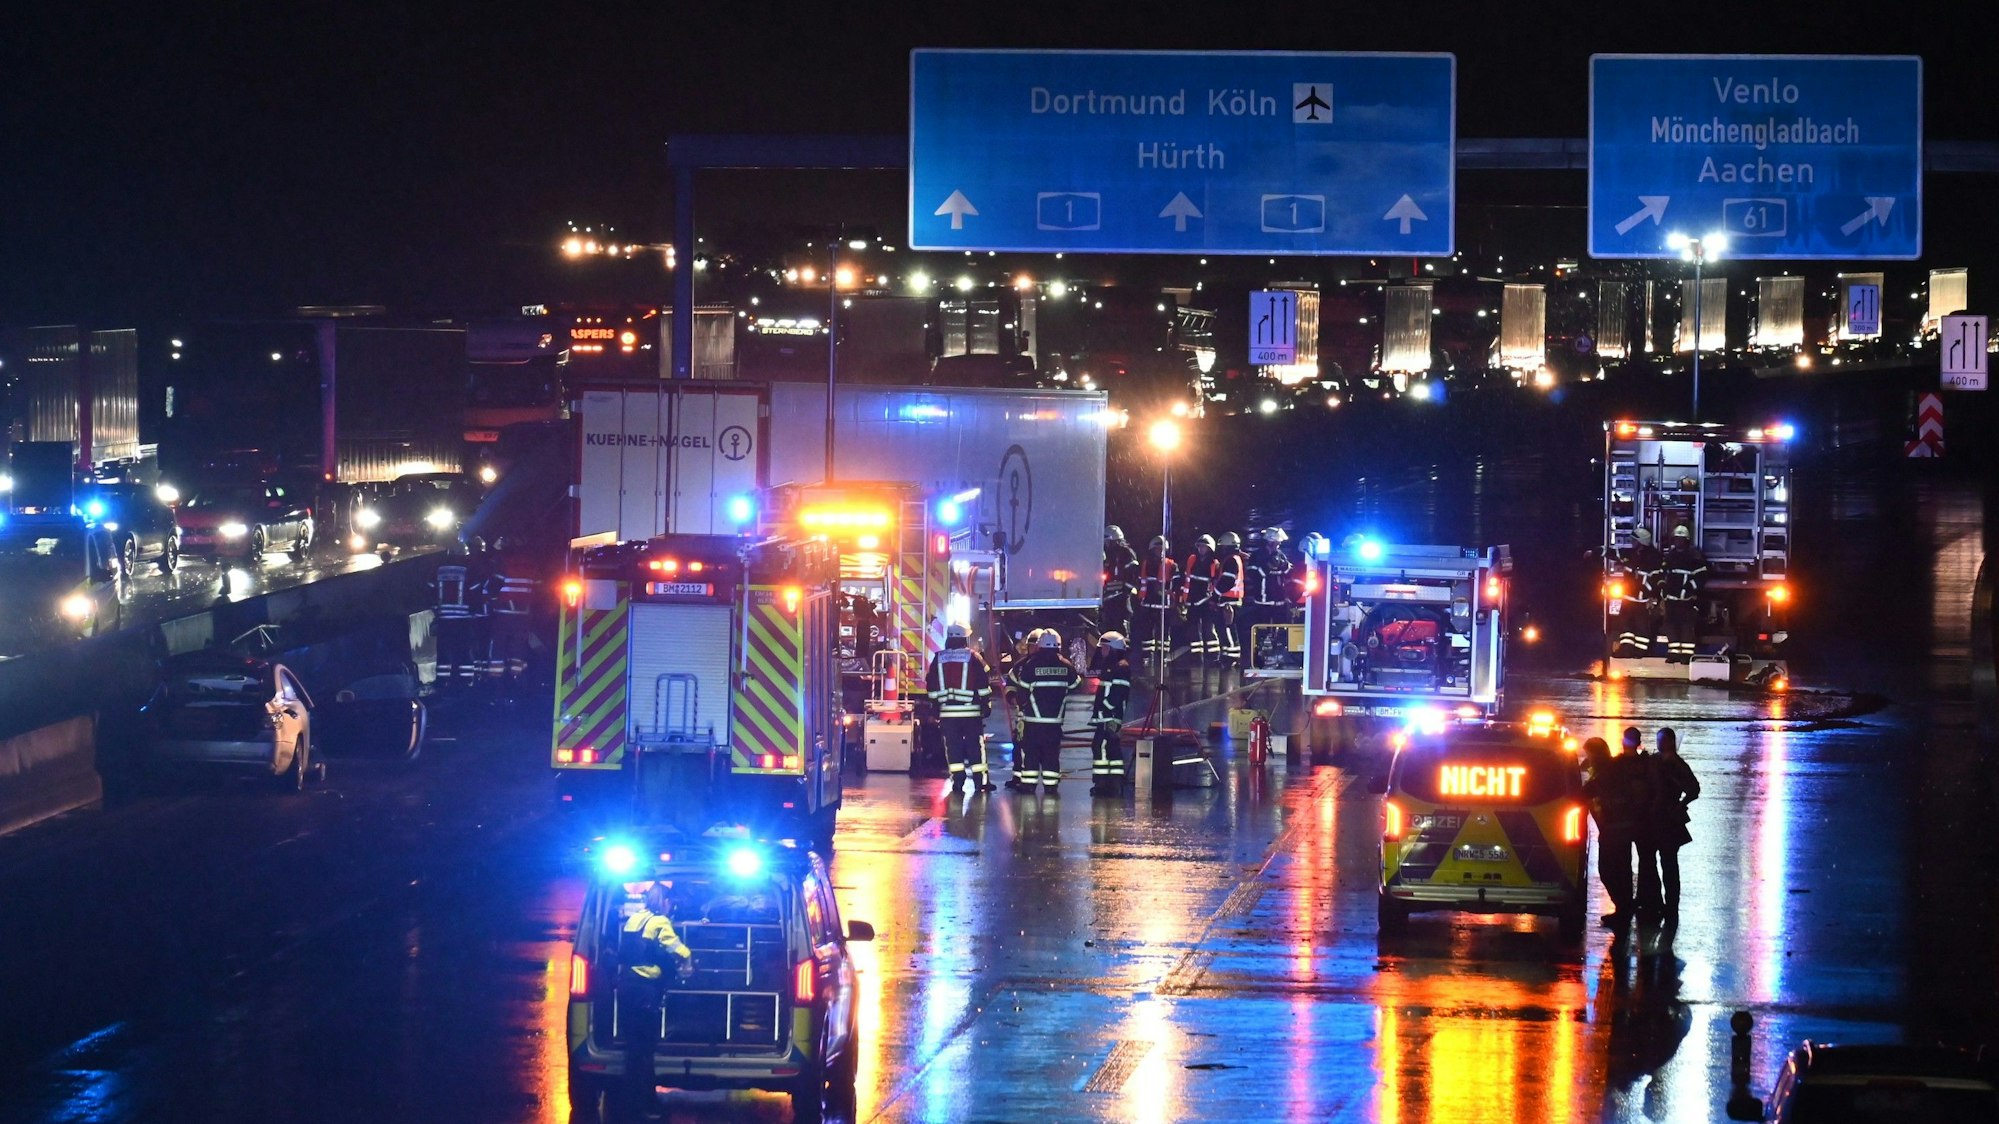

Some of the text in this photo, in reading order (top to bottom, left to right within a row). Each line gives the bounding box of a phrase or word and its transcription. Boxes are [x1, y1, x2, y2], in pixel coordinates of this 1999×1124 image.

[1031, 87, 1276, 117] Dortmund Köln
[1713, 77, 1799, 104] Venlo
[1651, 116, 1859, 150] Mönchengladbach
[1137, 142, 1225, 170] Hürth
[1698, 156, 1814, 184] Aachen
[1743, 206, 1767, 229] 61
[761, 327, 814, 336] STERNBERG
[1257, 351, 1287, 361] 400 m
[1950, 376, 1979, 386] 400 m
[586, 433, 711, 449] KUEHNE+NAGEL
[663, 584, 703, 593] BM 2112
[1036, 667, 1066, 675] FEUERWEHR
[1440, 765, 1526, 797] NICHT
